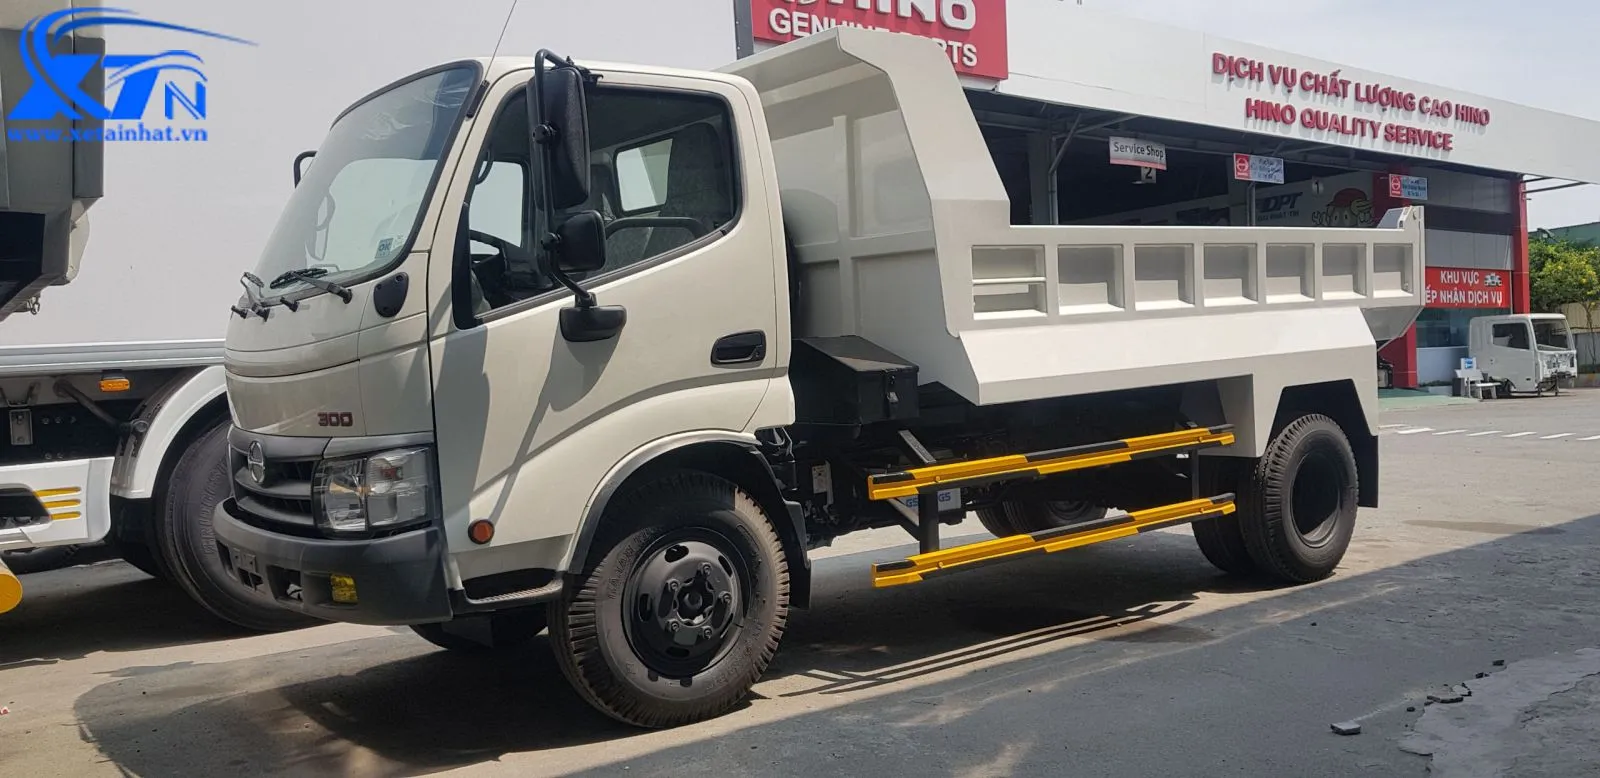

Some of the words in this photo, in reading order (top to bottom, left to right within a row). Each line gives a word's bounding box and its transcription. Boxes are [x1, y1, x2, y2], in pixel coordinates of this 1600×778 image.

[1212, 52, 1263, 82] DỊCH
[1268, 64, 1296, 93] VỤ
[1300, 69, 1351, 99] CHẤT
[1355, 83, 1416, 112] LƯỢNG
[1419, 96, 1453, 118] CAO
[1455, 104, 1490, 126] HINO
[1245, 98, 1296, 124] HINO
[1300, 108, 1380, 139] QUALITY
[1384, 123, 1453, 151] SERVICE
[1114, 142, 1145, 155] Service
[1147, 145, 1163, 160] Shop
[1144, 167, 1153, 179] 2
[1440, 270, 1459, 283] KHU
[1461, 270, 1479, 286] VỰC
[1440, 287, 1465, 306] NHẬN
[1468, 290, 1489, 306] DỊCH
[1490, 291, 1503, 307] VỤ
[318, 411, 353, 427] 300
[938, 491, 952, 503] GS
